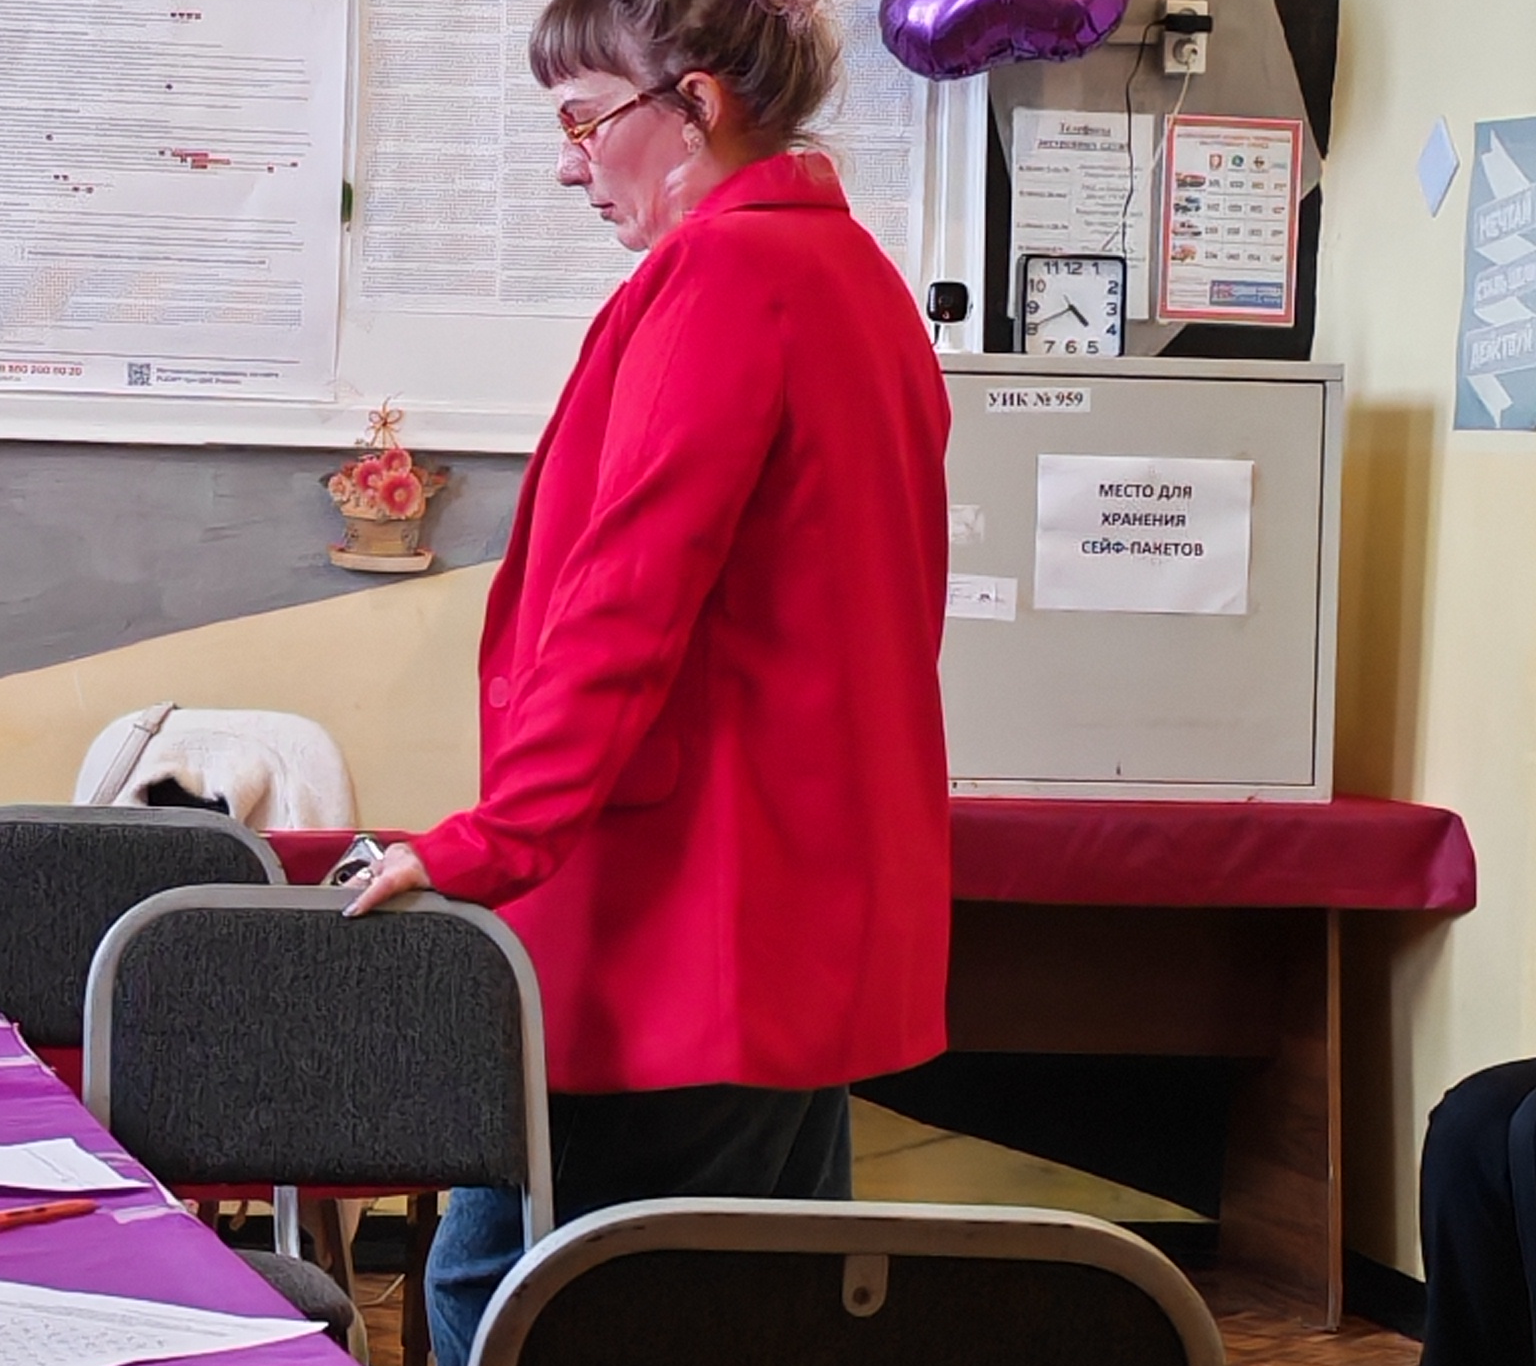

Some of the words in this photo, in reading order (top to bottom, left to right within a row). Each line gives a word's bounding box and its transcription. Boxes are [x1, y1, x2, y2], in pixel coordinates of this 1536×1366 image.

[1479, 189, 1532, 243] МЕЧТАЙ
[1044, 260, 1059, 275] 11
[1064, 261, 1083, 275] 12
[1091, 261, 1100, 275] 1
[1029, 278, 1046, 293] 10
[1107, 280, 1119, 295] 2
[1027, 300, 1040, 315] 9
[1106, 302, 1117, 316] 3
[1026, 322, 1039, 336] 8
[1106, 323, 1117, 336] 4
[1043, 340, 1056, 354] 7
[1065, 340, 1077, 354] 6
[1086, 340, 1099, 354] 5
[987, 391, 1028, 408] УИК
[1033, 391, 1052, 408] №
[1055, 391, 1084, 408] 959
[1098, 483, 1155, 500] МЕСТО
[1157, 485, 1193, 502] ДЛЯ
[1100, 512, 1187, 528] ХРАНЕНИЯ
[1080, 537, 1205, 558] СЕЙФ-ПАКЕТОВ
